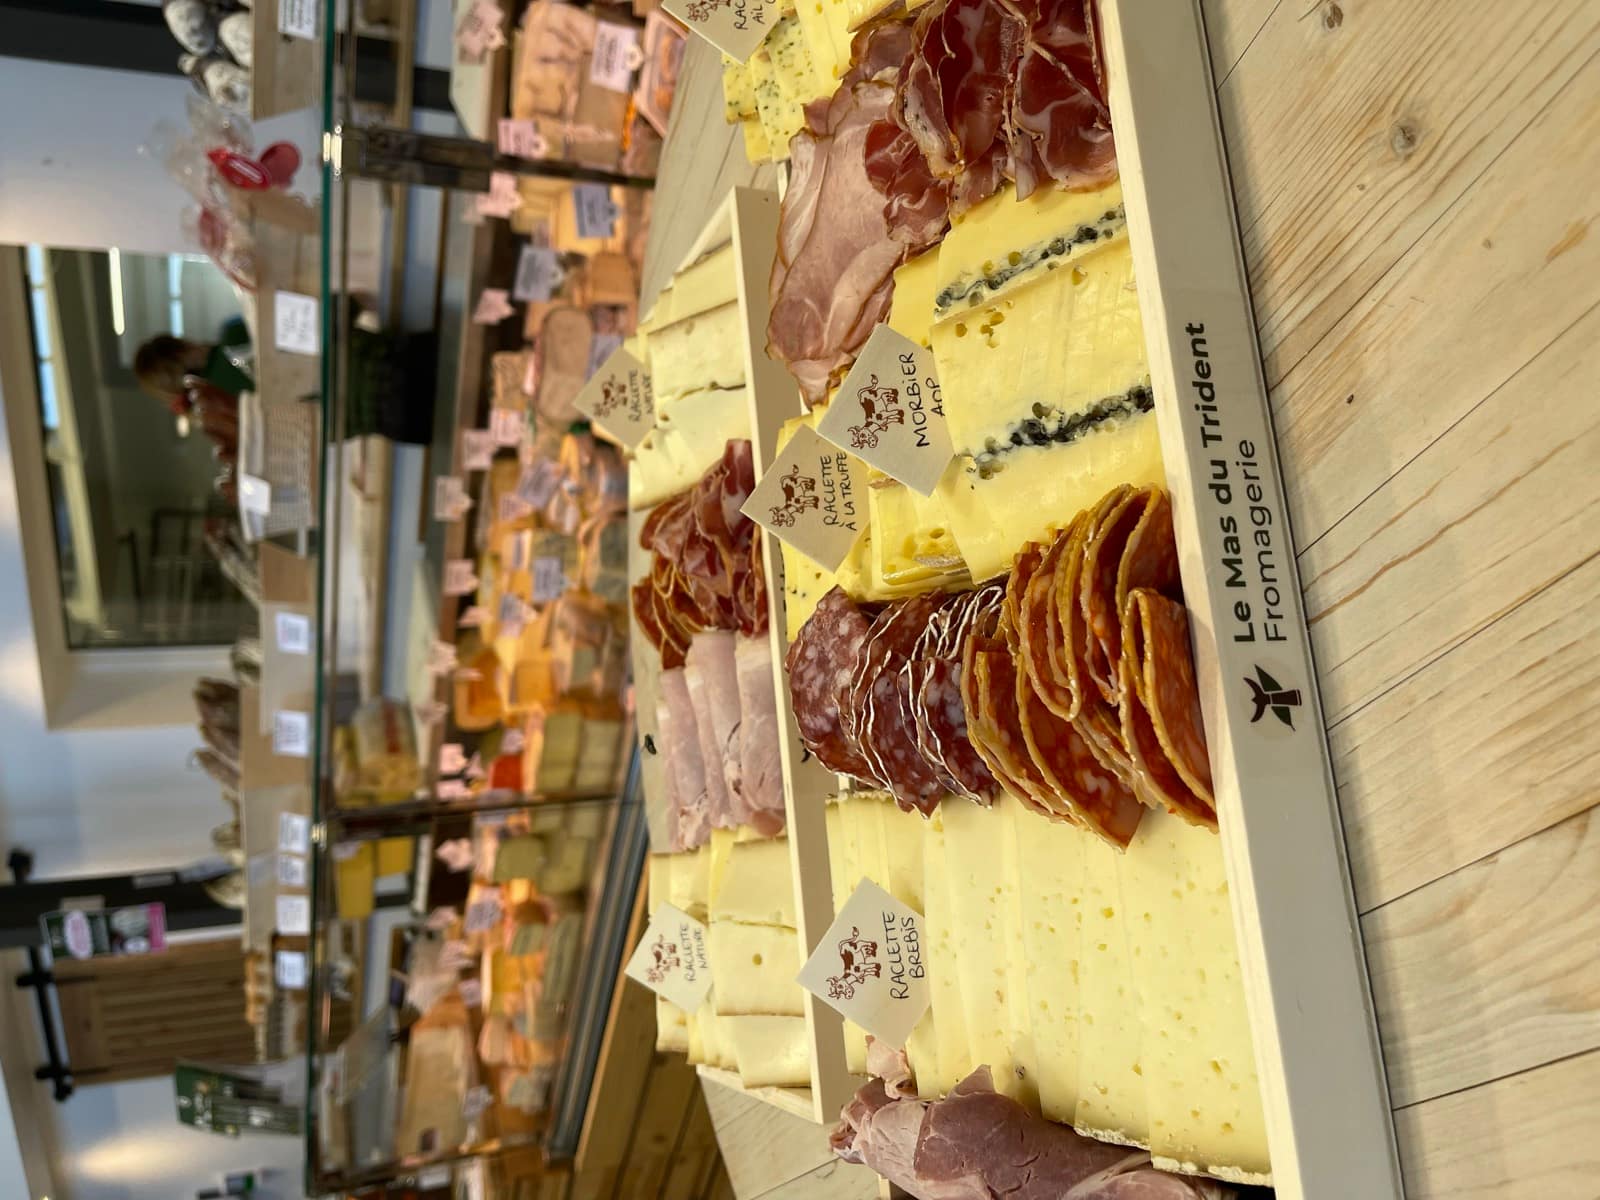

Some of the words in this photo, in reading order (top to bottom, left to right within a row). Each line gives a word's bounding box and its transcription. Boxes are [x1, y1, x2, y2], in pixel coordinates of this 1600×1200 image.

[1185, 322, 1223, 449] Trident
[820, 455, 839, 526] RACLETTE
[836, 451, 852, 499] TRUFFE
[1208, 459, 1234, 504] du
[839, 521, 857, 531] À
[844, 501, 855, 515] LA
[1218, 515, 1247, 588] Mas
[1234, 439, 1288, 643] Fromagerie
[1233, 602, 1256, 643] Le
[680, 922, 696, 982] RACLETTE
[882, 911, 910, 999] RACLETTE
